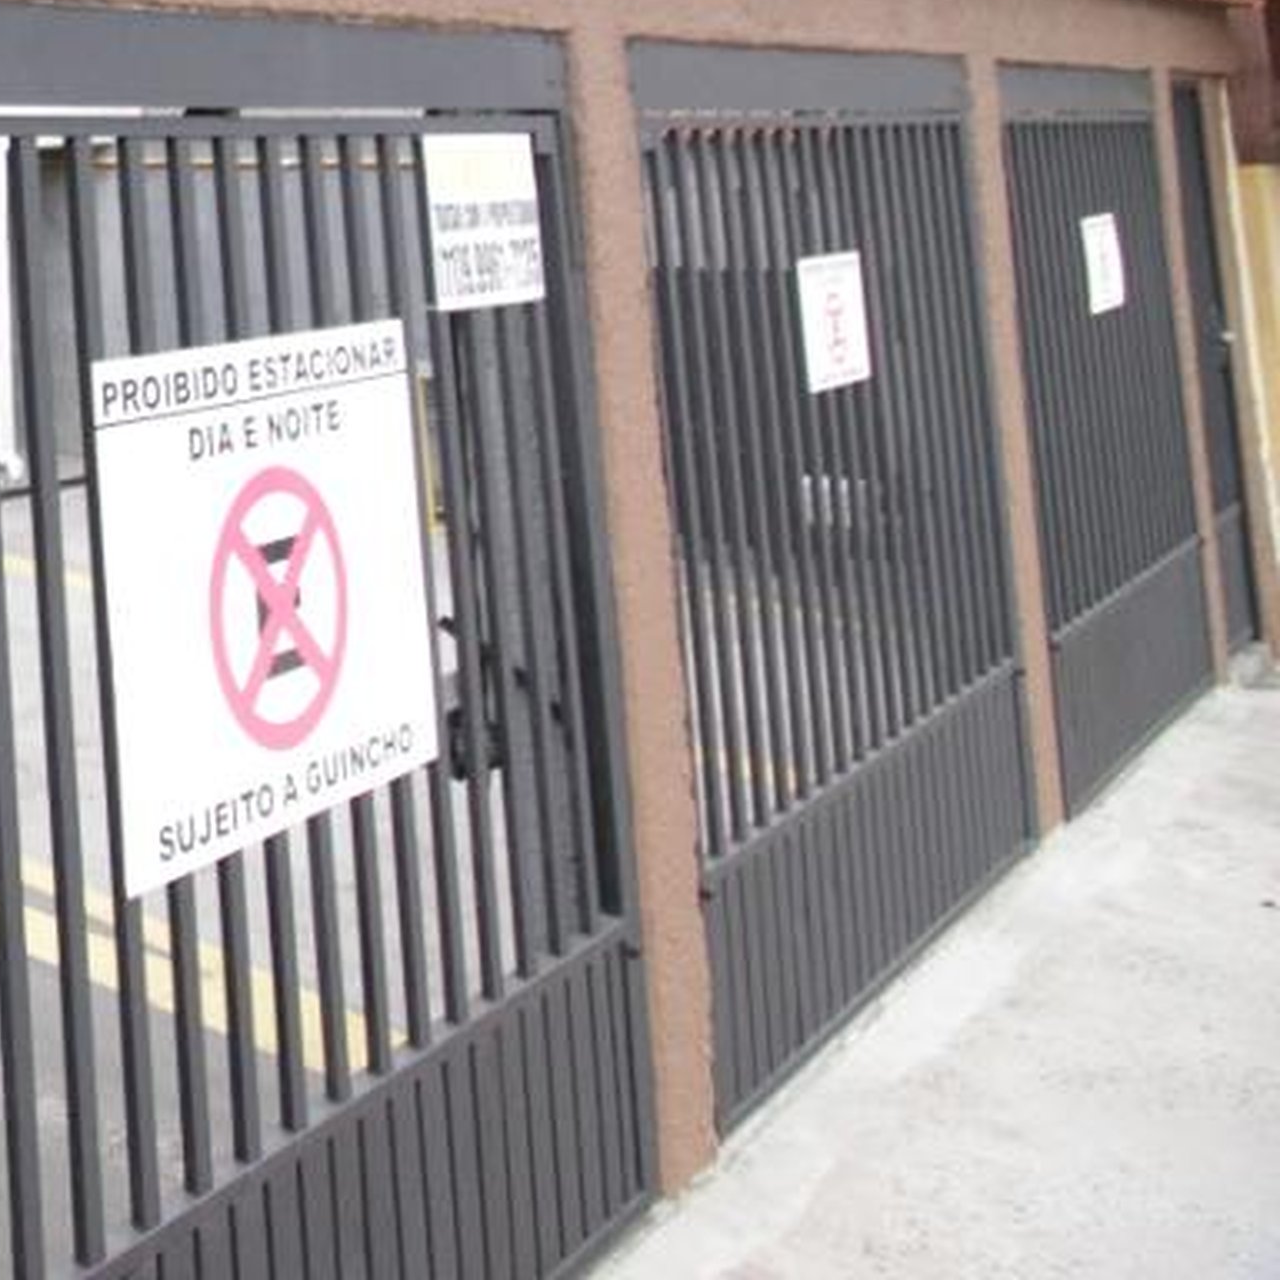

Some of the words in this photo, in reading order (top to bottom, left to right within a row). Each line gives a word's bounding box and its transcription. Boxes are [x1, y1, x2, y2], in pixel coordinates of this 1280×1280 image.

[101, 362, 239, 417] PROIBIDO
[247, 336, 398, 392] ESTACIONAR
[188, 422, 235, 462] DIA
[243, 416, 258, 449] E
[266, 399, 342, 443] NOITE
[158, 782, 276, 863] SUJEITO
[282, 773, 299, 807] A
[306, 723, 415, 797] GUINCHO
